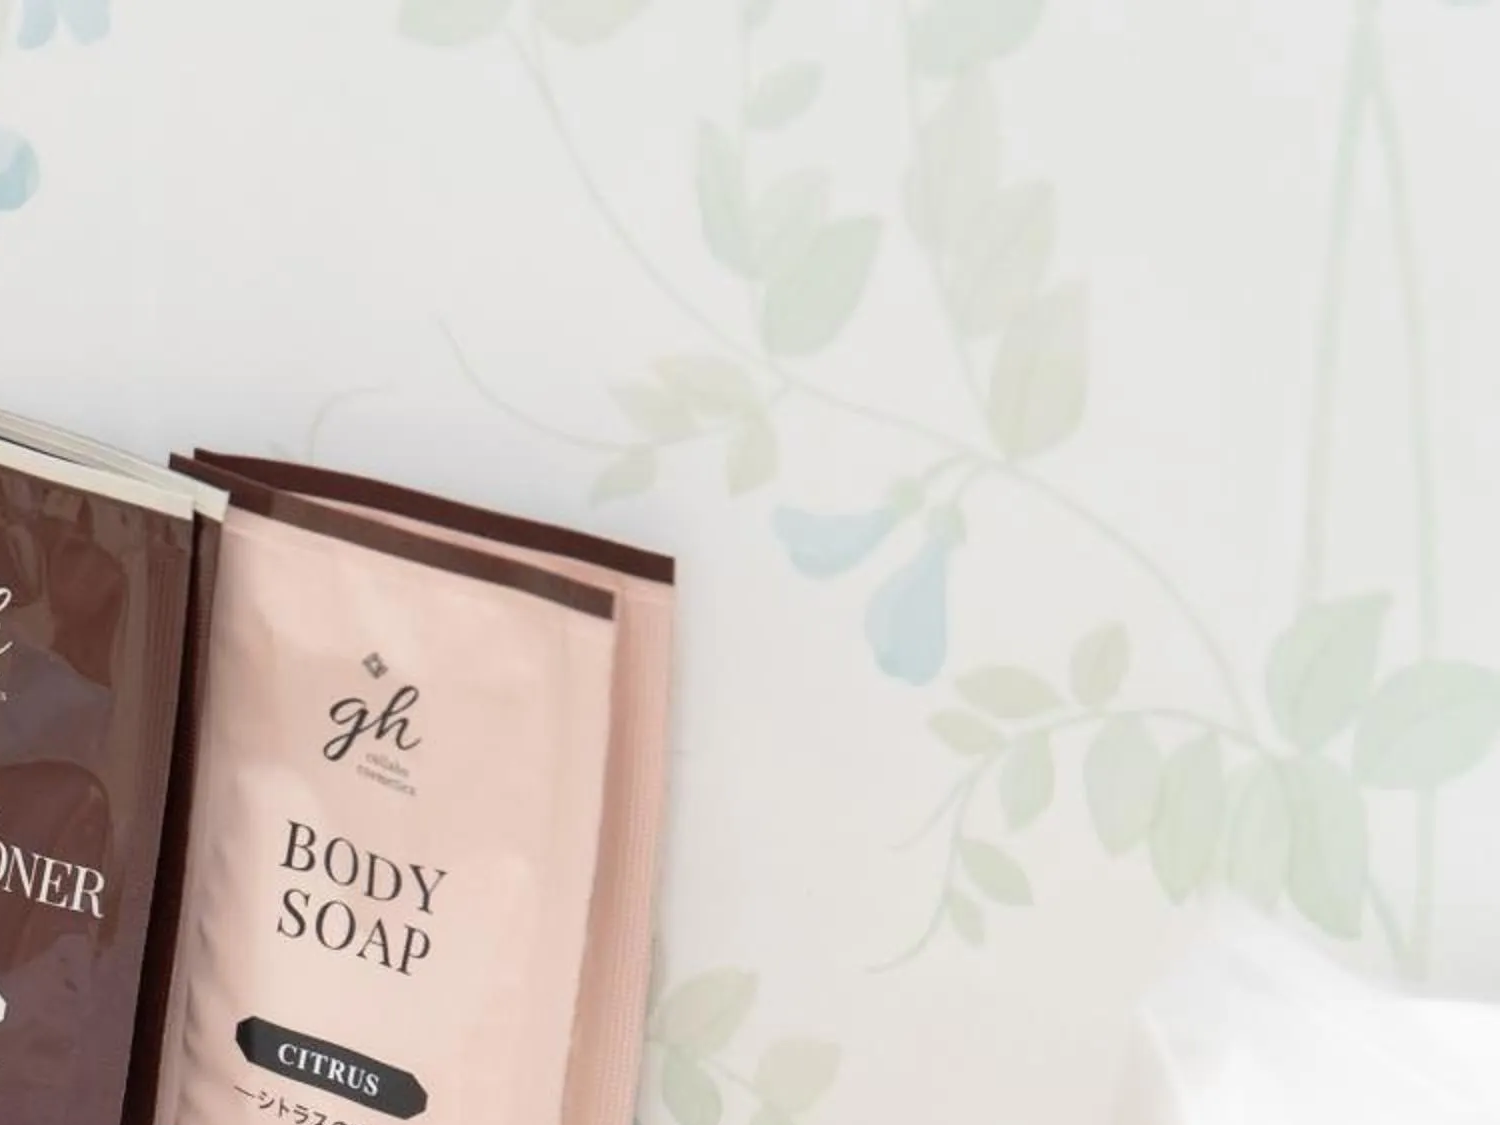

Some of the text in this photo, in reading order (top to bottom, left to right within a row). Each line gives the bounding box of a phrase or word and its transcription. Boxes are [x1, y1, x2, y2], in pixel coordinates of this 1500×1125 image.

[322, 685, 423, 762] gh
[279, 818, 448, 916] BODY
[275, 887, 433, 977] SOAP
[276, 1042, 382, 1098] CITRUS
